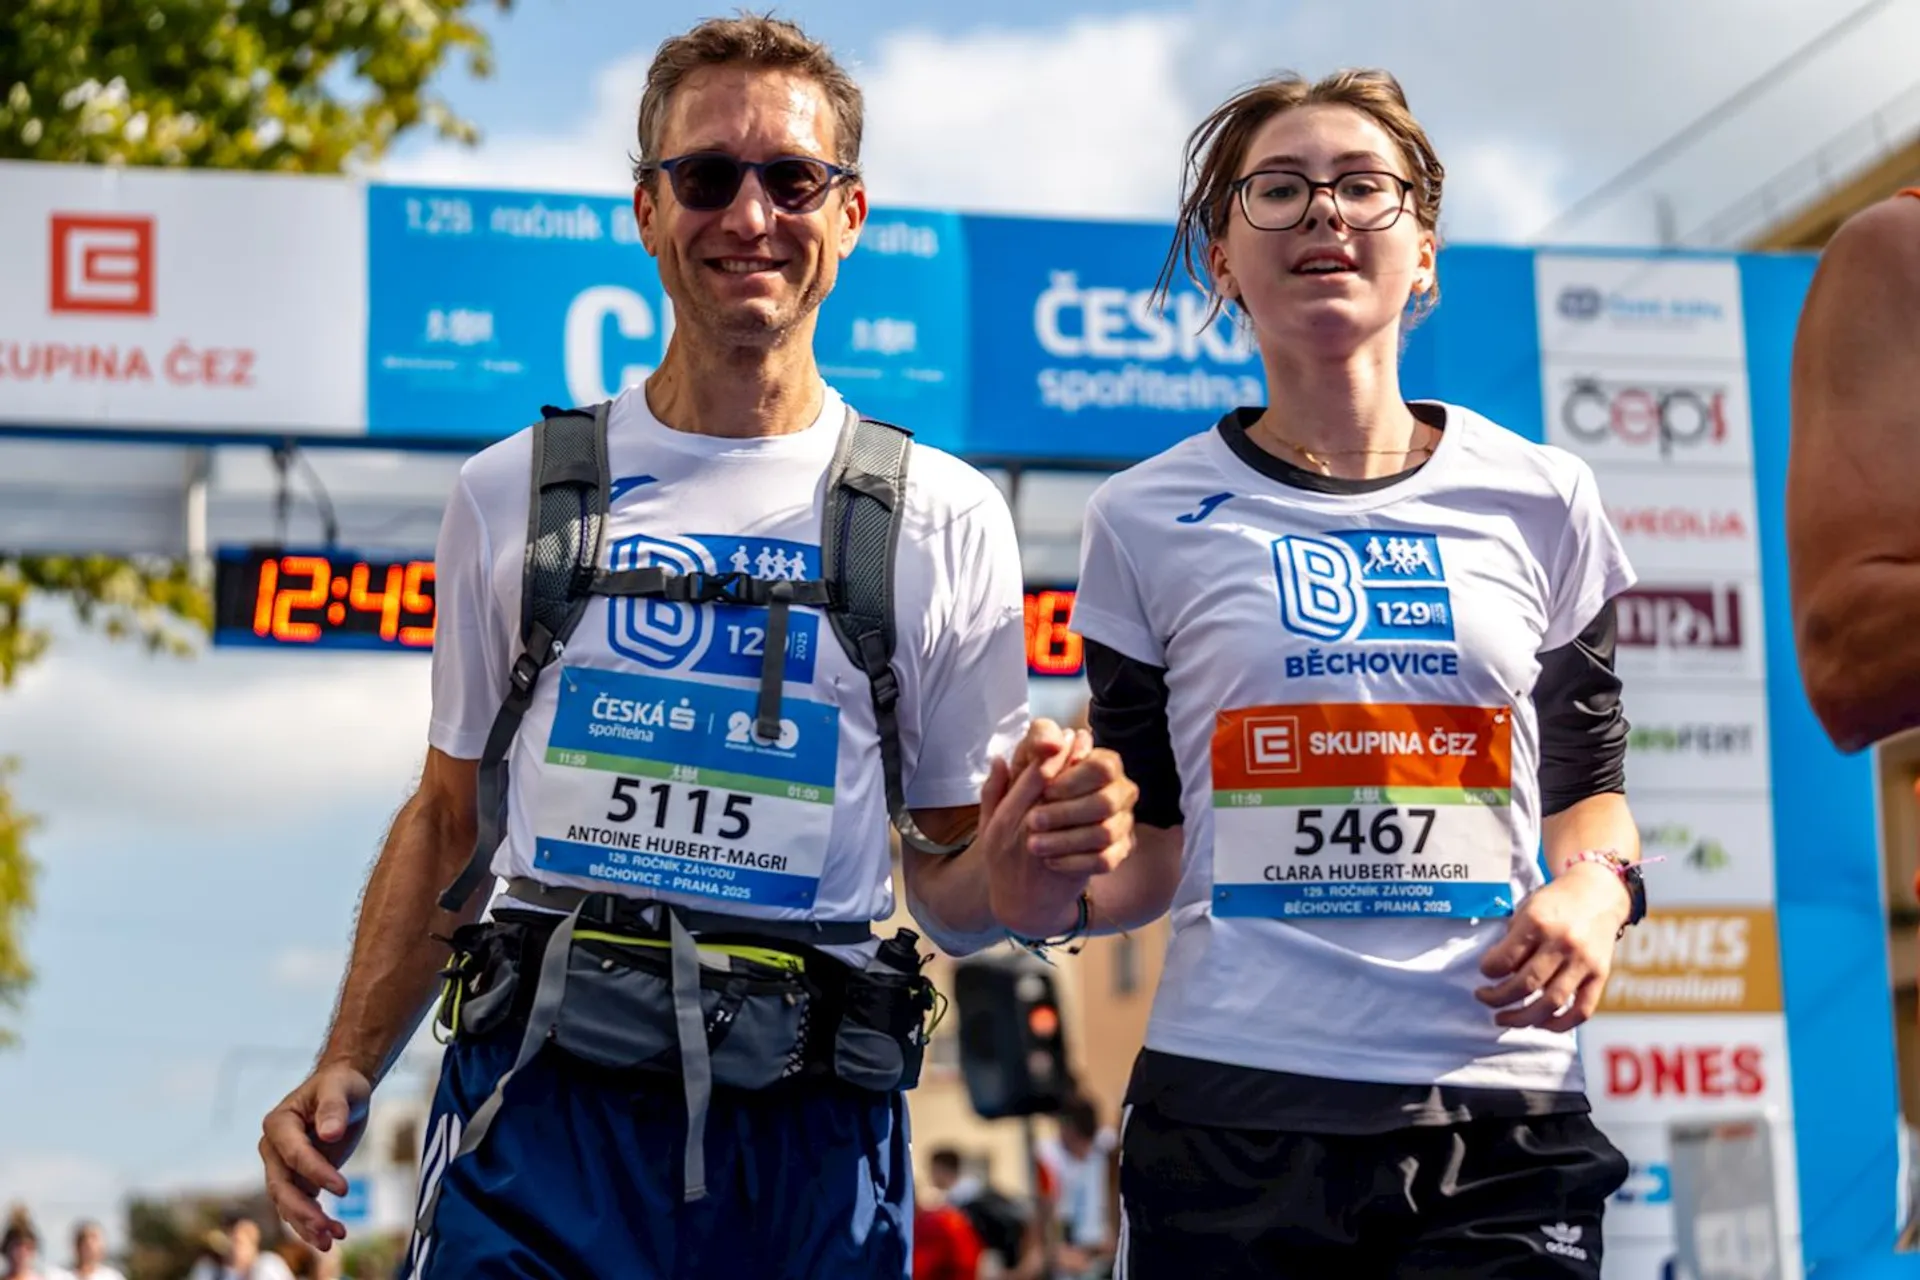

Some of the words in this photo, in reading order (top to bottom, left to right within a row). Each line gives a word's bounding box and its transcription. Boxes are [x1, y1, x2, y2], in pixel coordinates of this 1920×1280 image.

[163, 338, 256, 388] ČEZ
[1376, 601, 1431, 626] 129
[727, 625, 790, 655] 12
[1285, 649, 1458, 678] BĚCHOVICE
[592, 692, 665, 727] ČESKÁ
[588, 721, 654, 742] spořitelna
[1309, 731, 1424, 755] SKUPINA
[1429, 727, 1477, 755] ČEZ
[788, 785, 819, 801] 01:00
[606, 776, 753, 840] 5115
[1294, 808, 1437, 855] 5467
[566, 825, 641, 850] ANTOINE
[646, 836, 788, 871] HUBERT-MAGRI
[589, 863, 662, 886] BĚCHOVICE
[673, 878, 719, 895] PRAHA
[722, 884, 751, 899] 2025
[608, 852, 628, 865] 129.
[632, 852, 680, 872] ROČNÍK
[683, 860, 736, 881] ZÁVODU
[1263, 865, 1323, 881] CLARA
[1328, 863, 1469, 880] HUBERT-MAGRI
[1330, 884, 1379, 897] ROČNÍK
[1382, 884, 1433, 897] ZÁVODU
[1284, 899, 1362, 914] BĚCHOVICE
[1374, 900, 1421, 913] PRAHA
[1424, 900, 1452, 913] 2025
[1606, 1045, 1764, 1097] DNES
[1545, 1241, 1588, 1261] adidas
